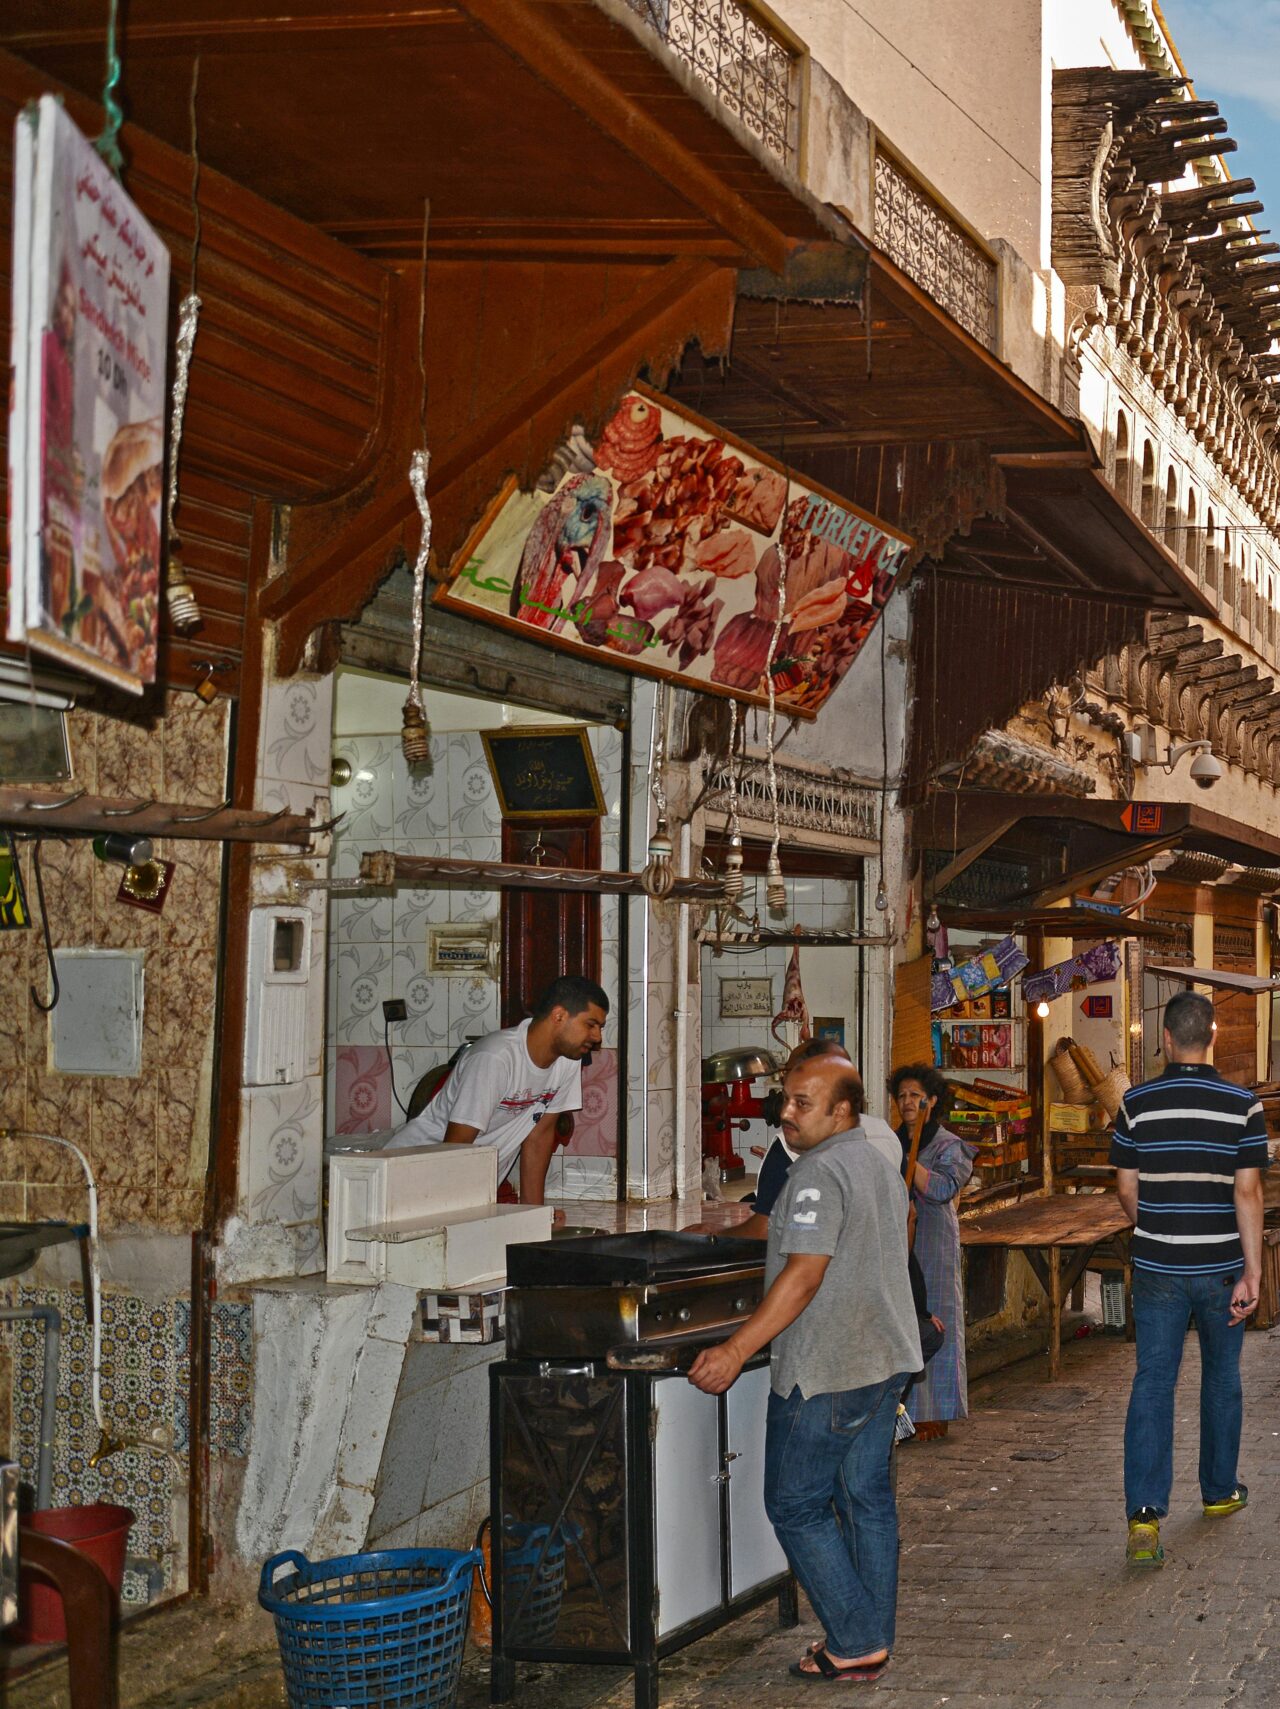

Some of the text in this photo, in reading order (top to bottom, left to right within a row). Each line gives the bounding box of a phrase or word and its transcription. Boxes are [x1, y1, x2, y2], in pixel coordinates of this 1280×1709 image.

[98, 348, 111, 381] 10
[800, 493, 907, 577] TURKEY CL
